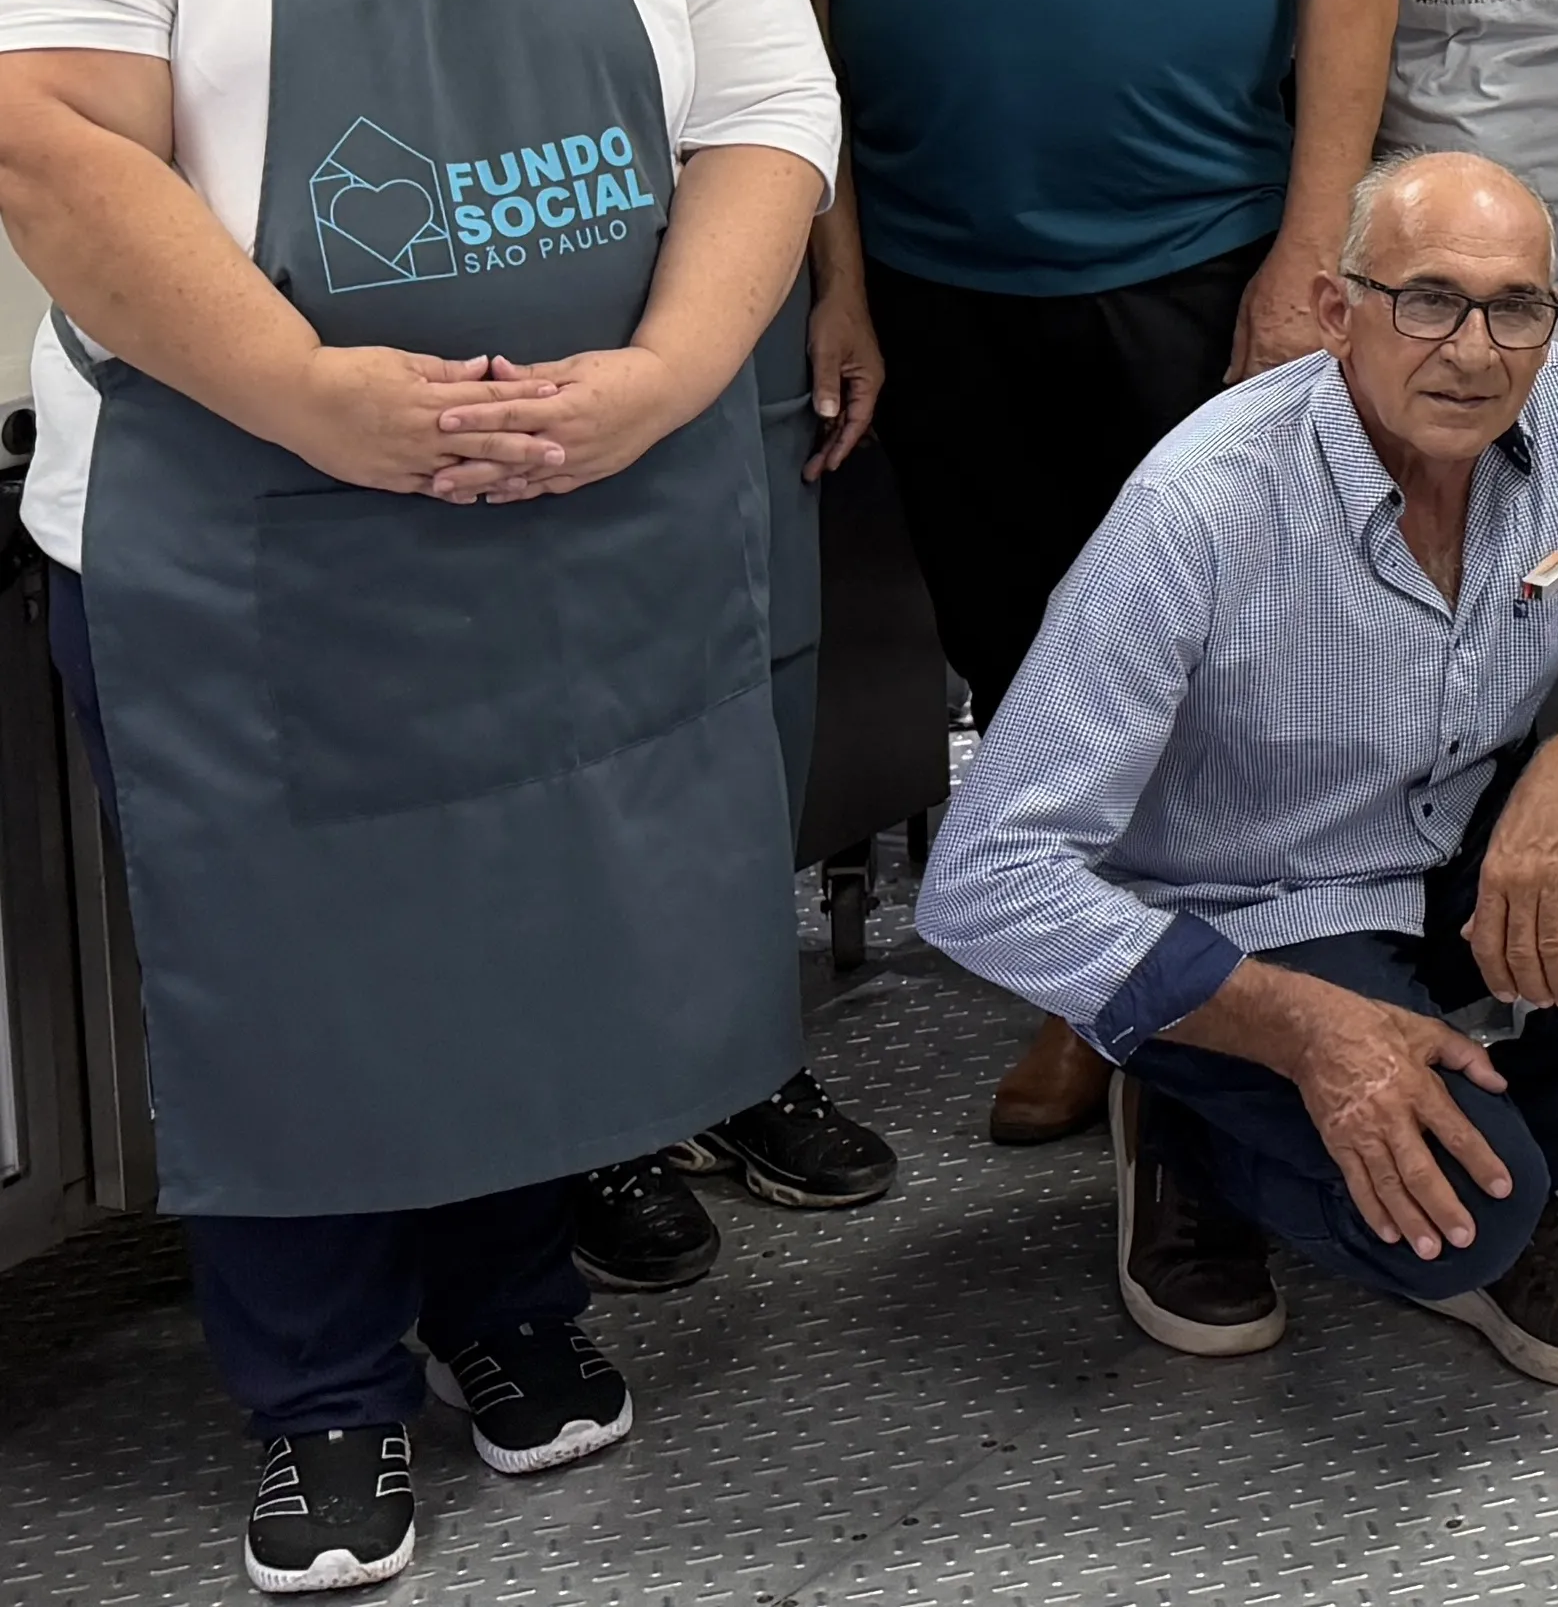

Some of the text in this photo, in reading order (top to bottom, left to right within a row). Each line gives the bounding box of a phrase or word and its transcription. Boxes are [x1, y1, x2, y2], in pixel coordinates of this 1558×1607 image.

[446, 126, 633, 202] FUNDO
[454, 168, 655, 245] SOCIAL
[464, 219, 628, 274] SÃO PAULO
